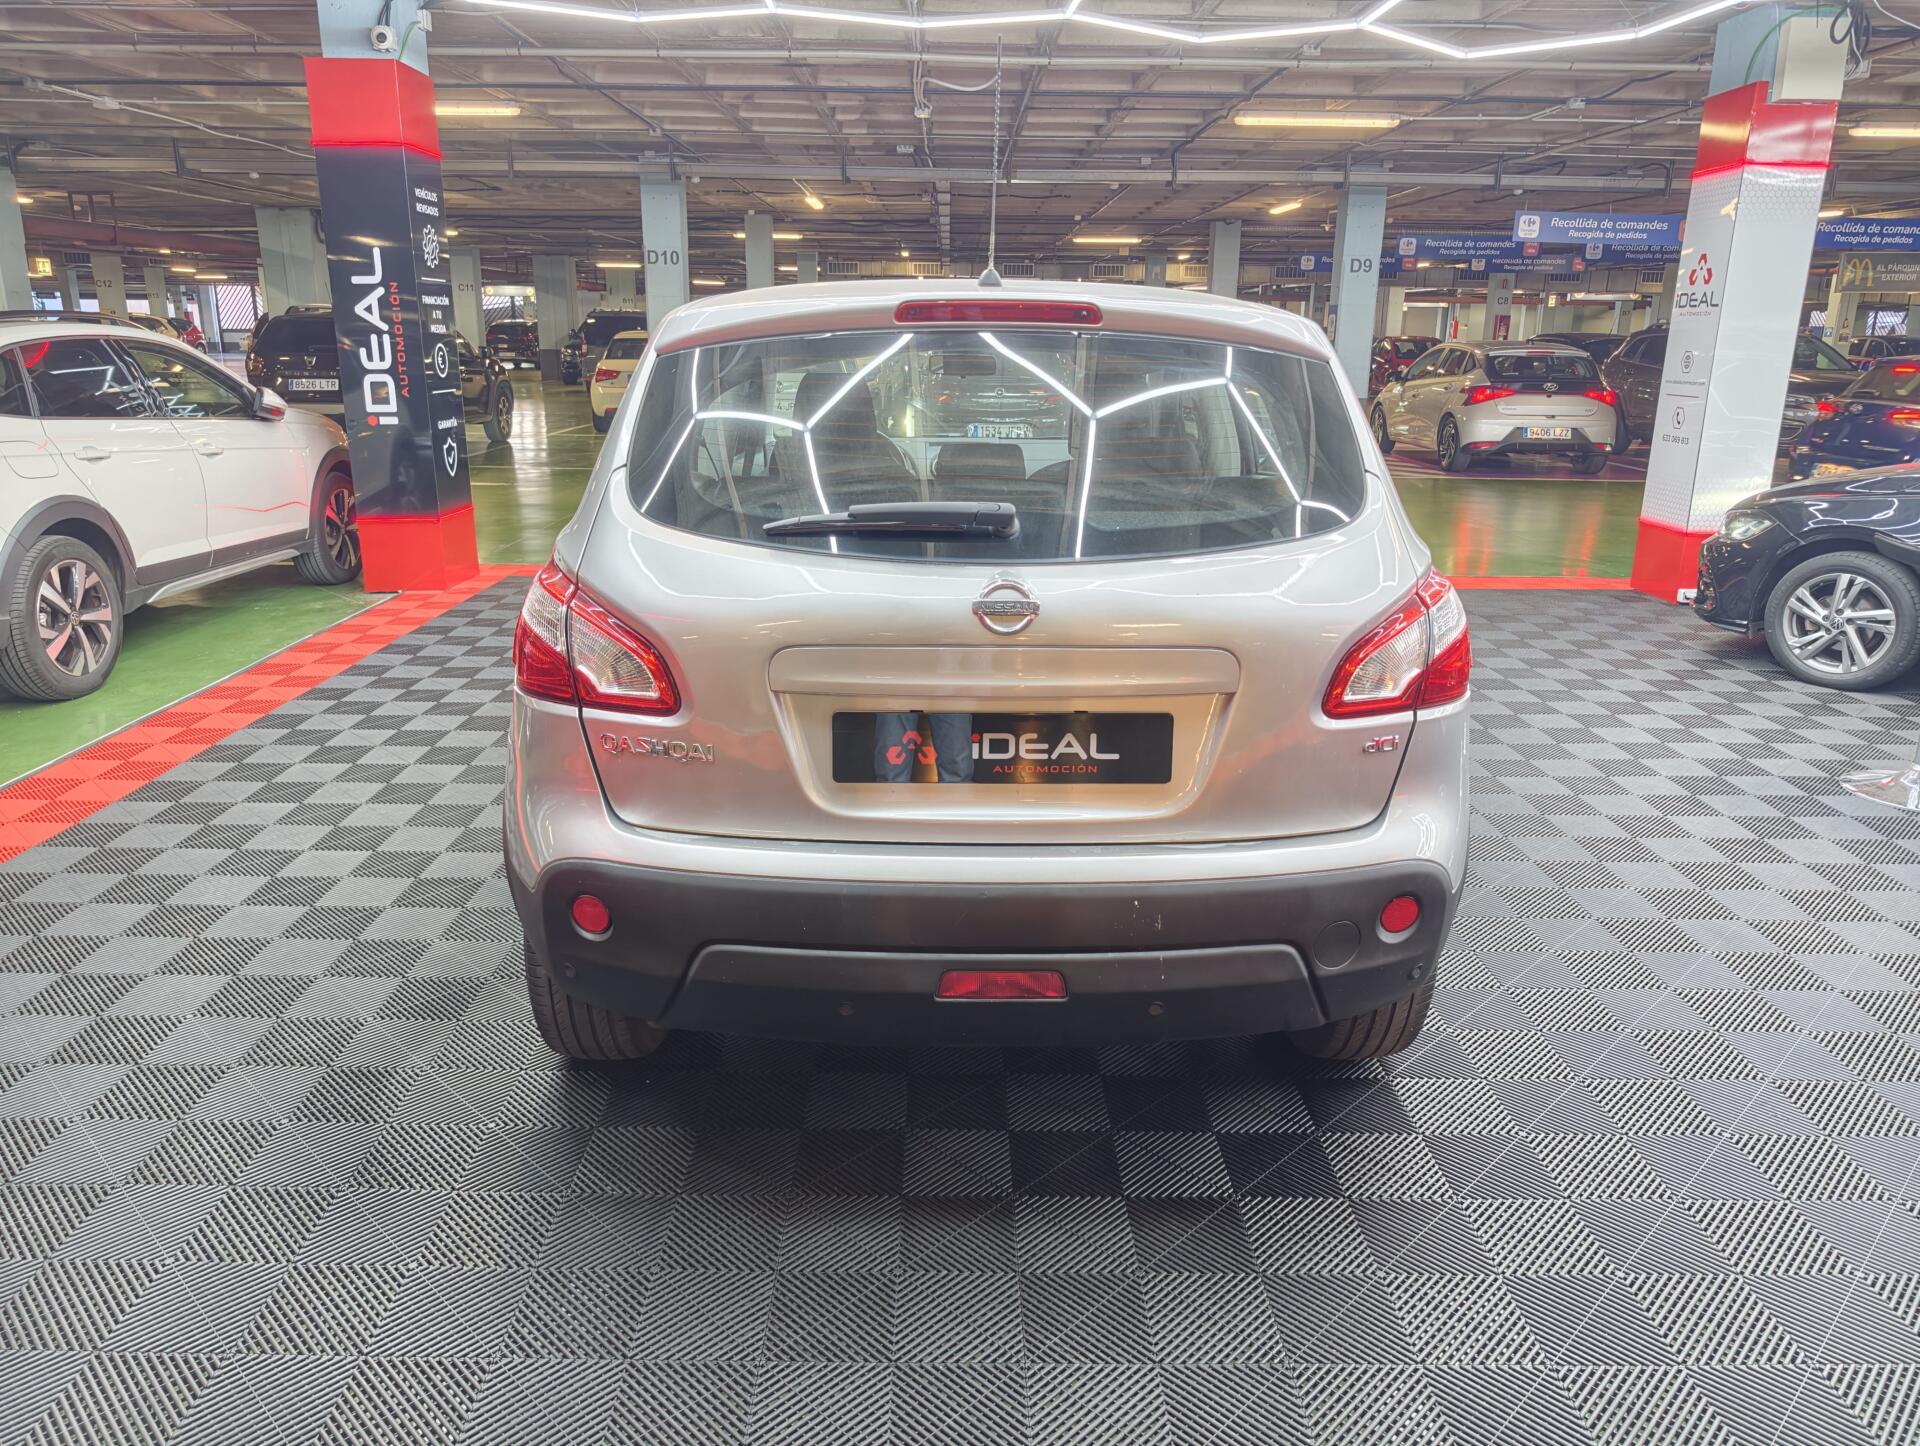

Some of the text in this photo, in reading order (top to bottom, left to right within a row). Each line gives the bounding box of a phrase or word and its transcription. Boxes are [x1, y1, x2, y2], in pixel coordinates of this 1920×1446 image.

[415, 187, 437, 202] VEHÍCULOS
[416, 203, 439, 216] REVISADOS
[1551, 217, 1668, 230] Recollida de comandes
[1817, 222, 1865, 233] Recollida
[1867, 224, 1880, 233] de
[1568, 230, 1648, 240] Recogida de pedidos
[1834, 235, 1913, 244] Recogida de pedidos
[1425, 240, 1463, 248] Recollida
[1464, 240, 1475, 248] de
[1476, 240, 1516, 248] comandes
[647, 249, 680, 265] D10
[1439, 248, 1467, 256] Recogida
[1350, 258, 1373, 273] D9
[96, 280, 113, 288] C12
[458, 284, 475, 292] C11
[430, 323, 446, 333] MEDIDA
[389, 281, 410, 398] AUTOMOCIÓN
[294, 381, 337, 389] 8526 LTR
[437, 416, 458, 430] GARANTÍA
[1529, 428, 1569, 437] 9406 LZZ
[600, 732, 714, 762] QASHQAI
[993, 763, 1098, 774] AUTOMOCIÓN
